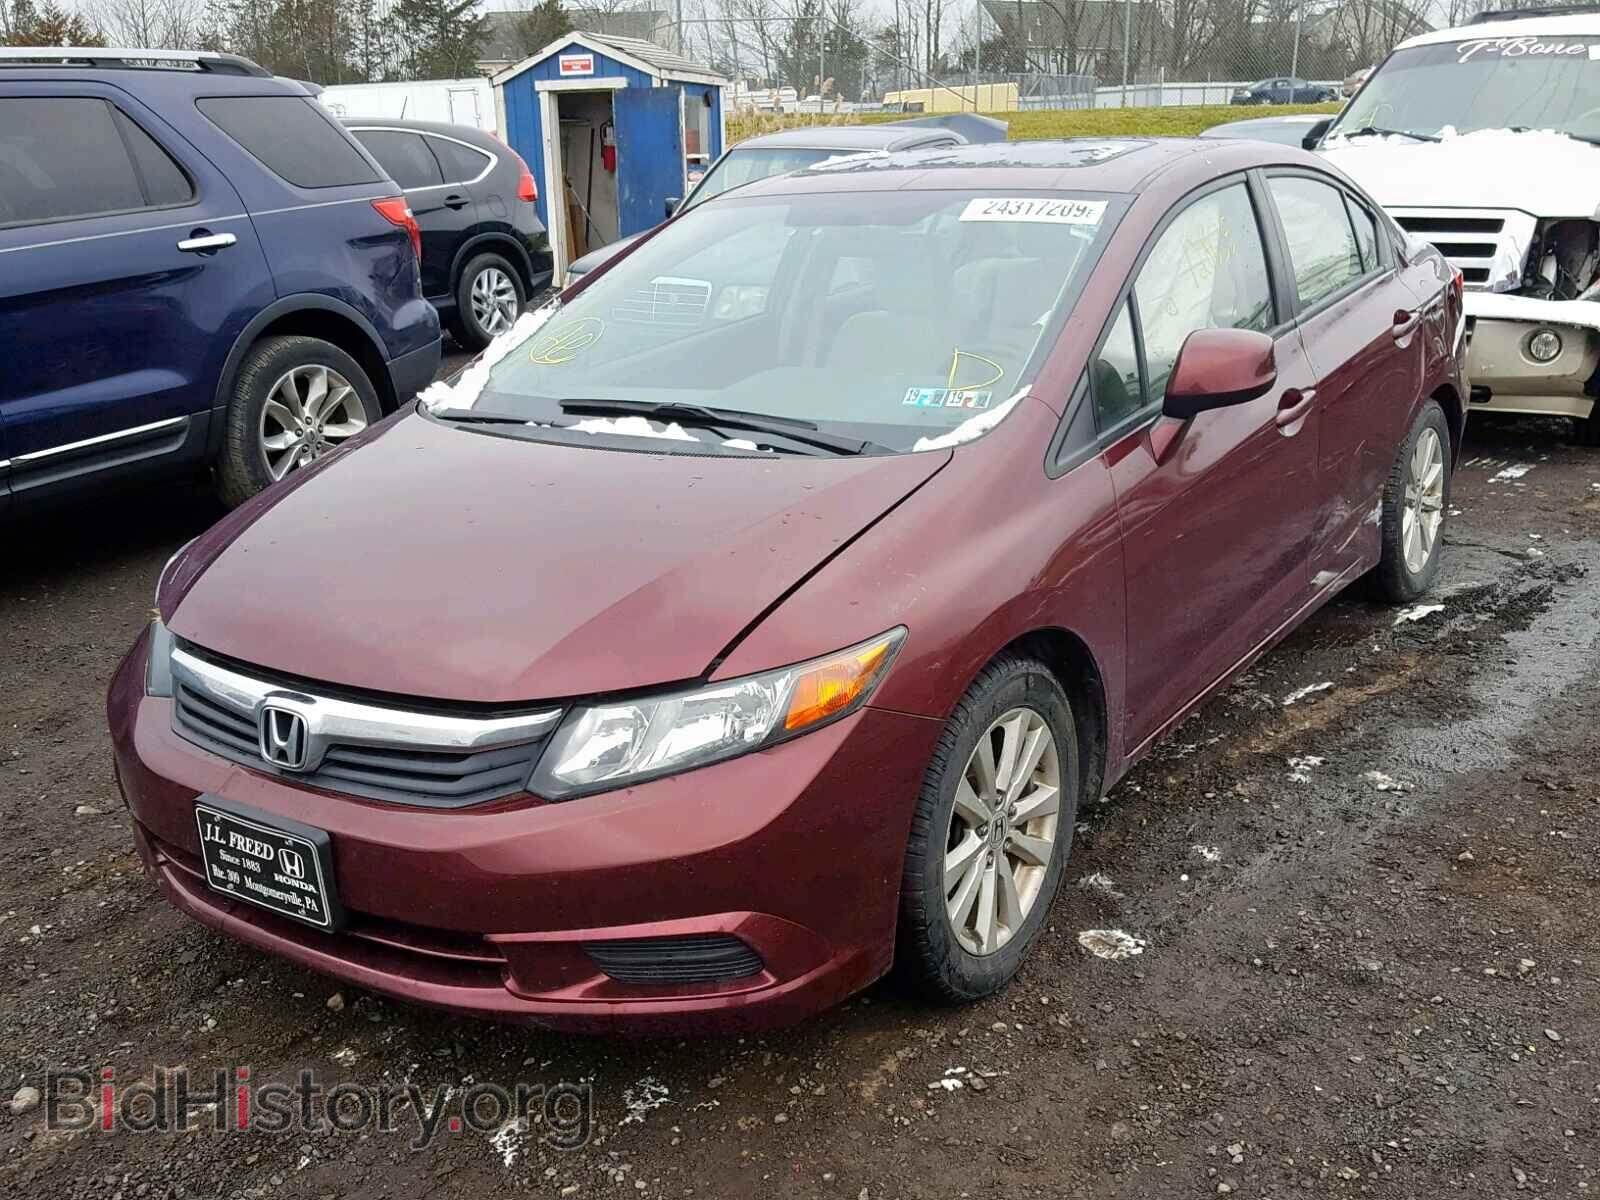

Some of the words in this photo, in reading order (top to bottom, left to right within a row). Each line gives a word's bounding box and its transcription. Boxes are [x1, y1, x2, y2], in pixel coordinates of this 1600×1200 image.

[228, 831, 275, 861] FREED
[273, 872, 319, 894] HONDA
[304, 896, 319, 912] PA
